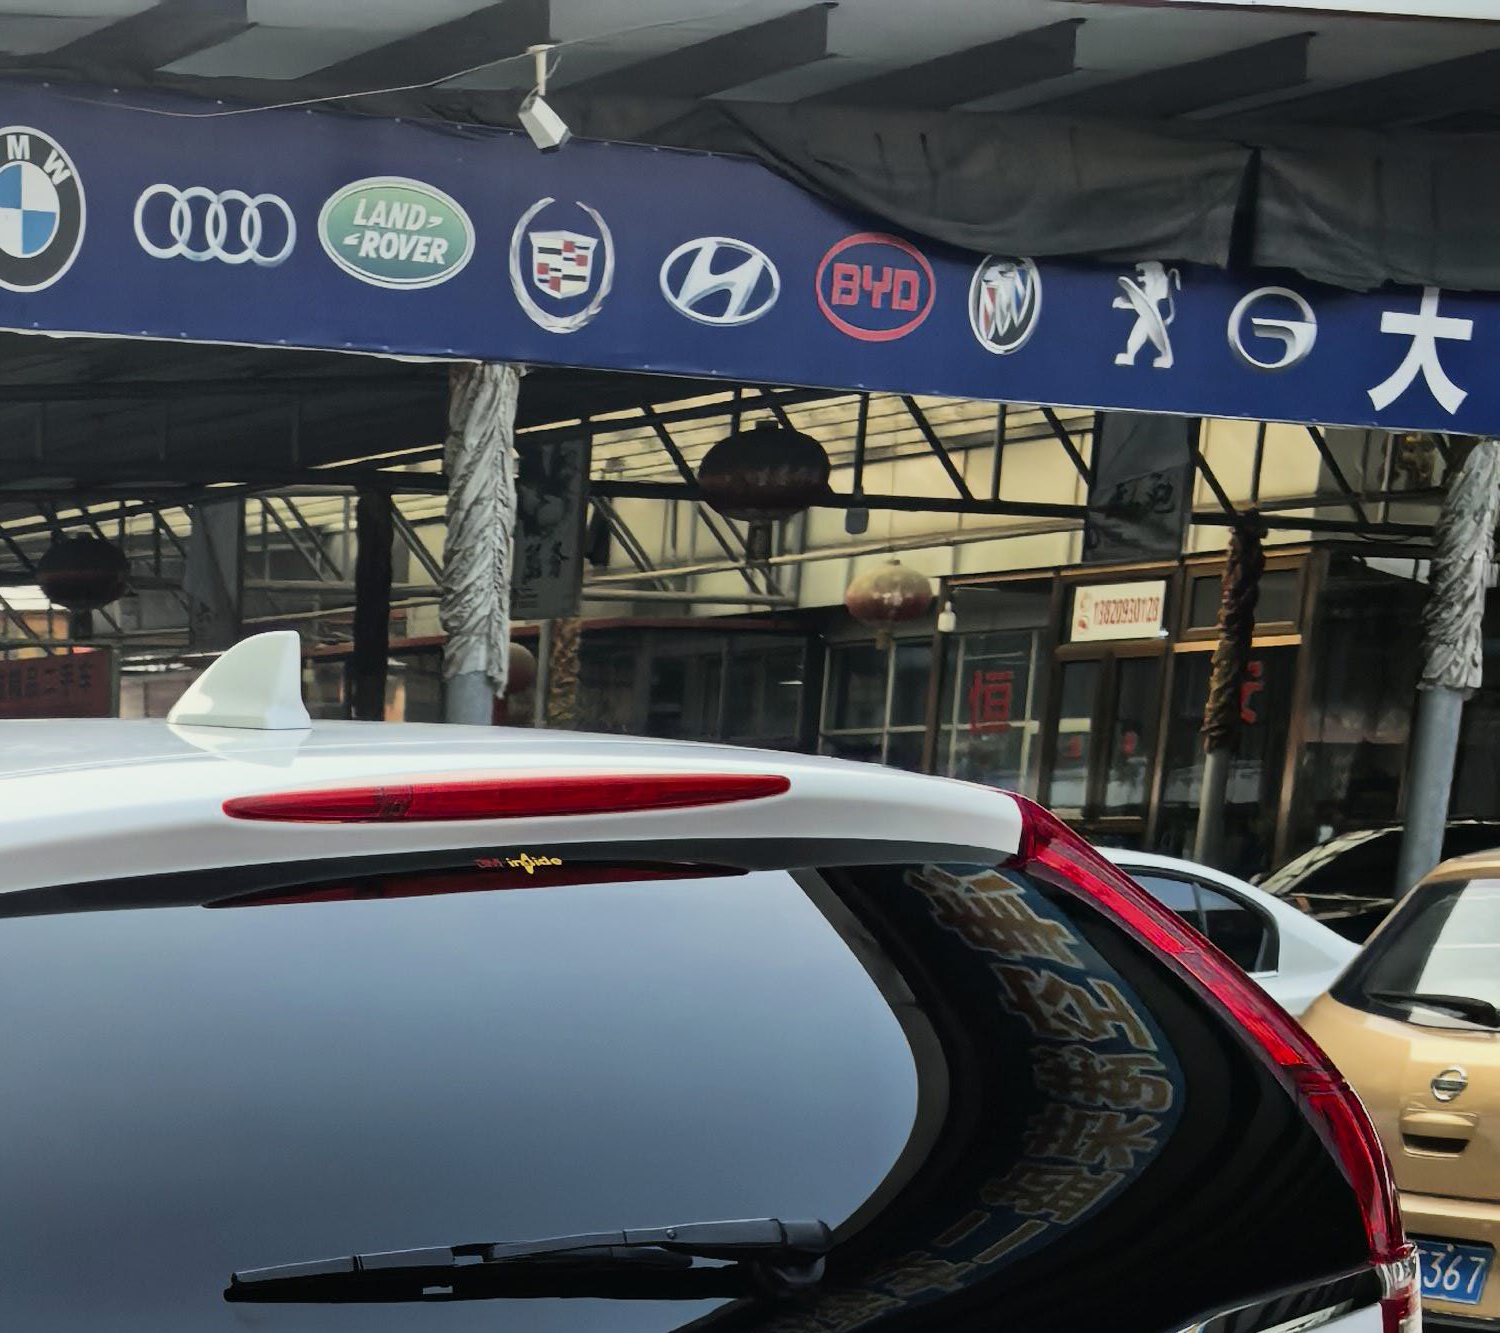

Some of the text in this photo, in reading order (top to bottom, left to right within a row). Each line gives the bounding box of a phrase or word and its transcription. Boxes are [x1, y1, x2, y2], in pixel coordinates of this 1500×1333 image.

[353, 198, 427, 231] LAND
[358, 230, 449, 265] ROVER
[831, 262, 920, 311] BYD
[1367, 286, 1474, 415] 大
[1418, 1249, 1487, 1294] 367
